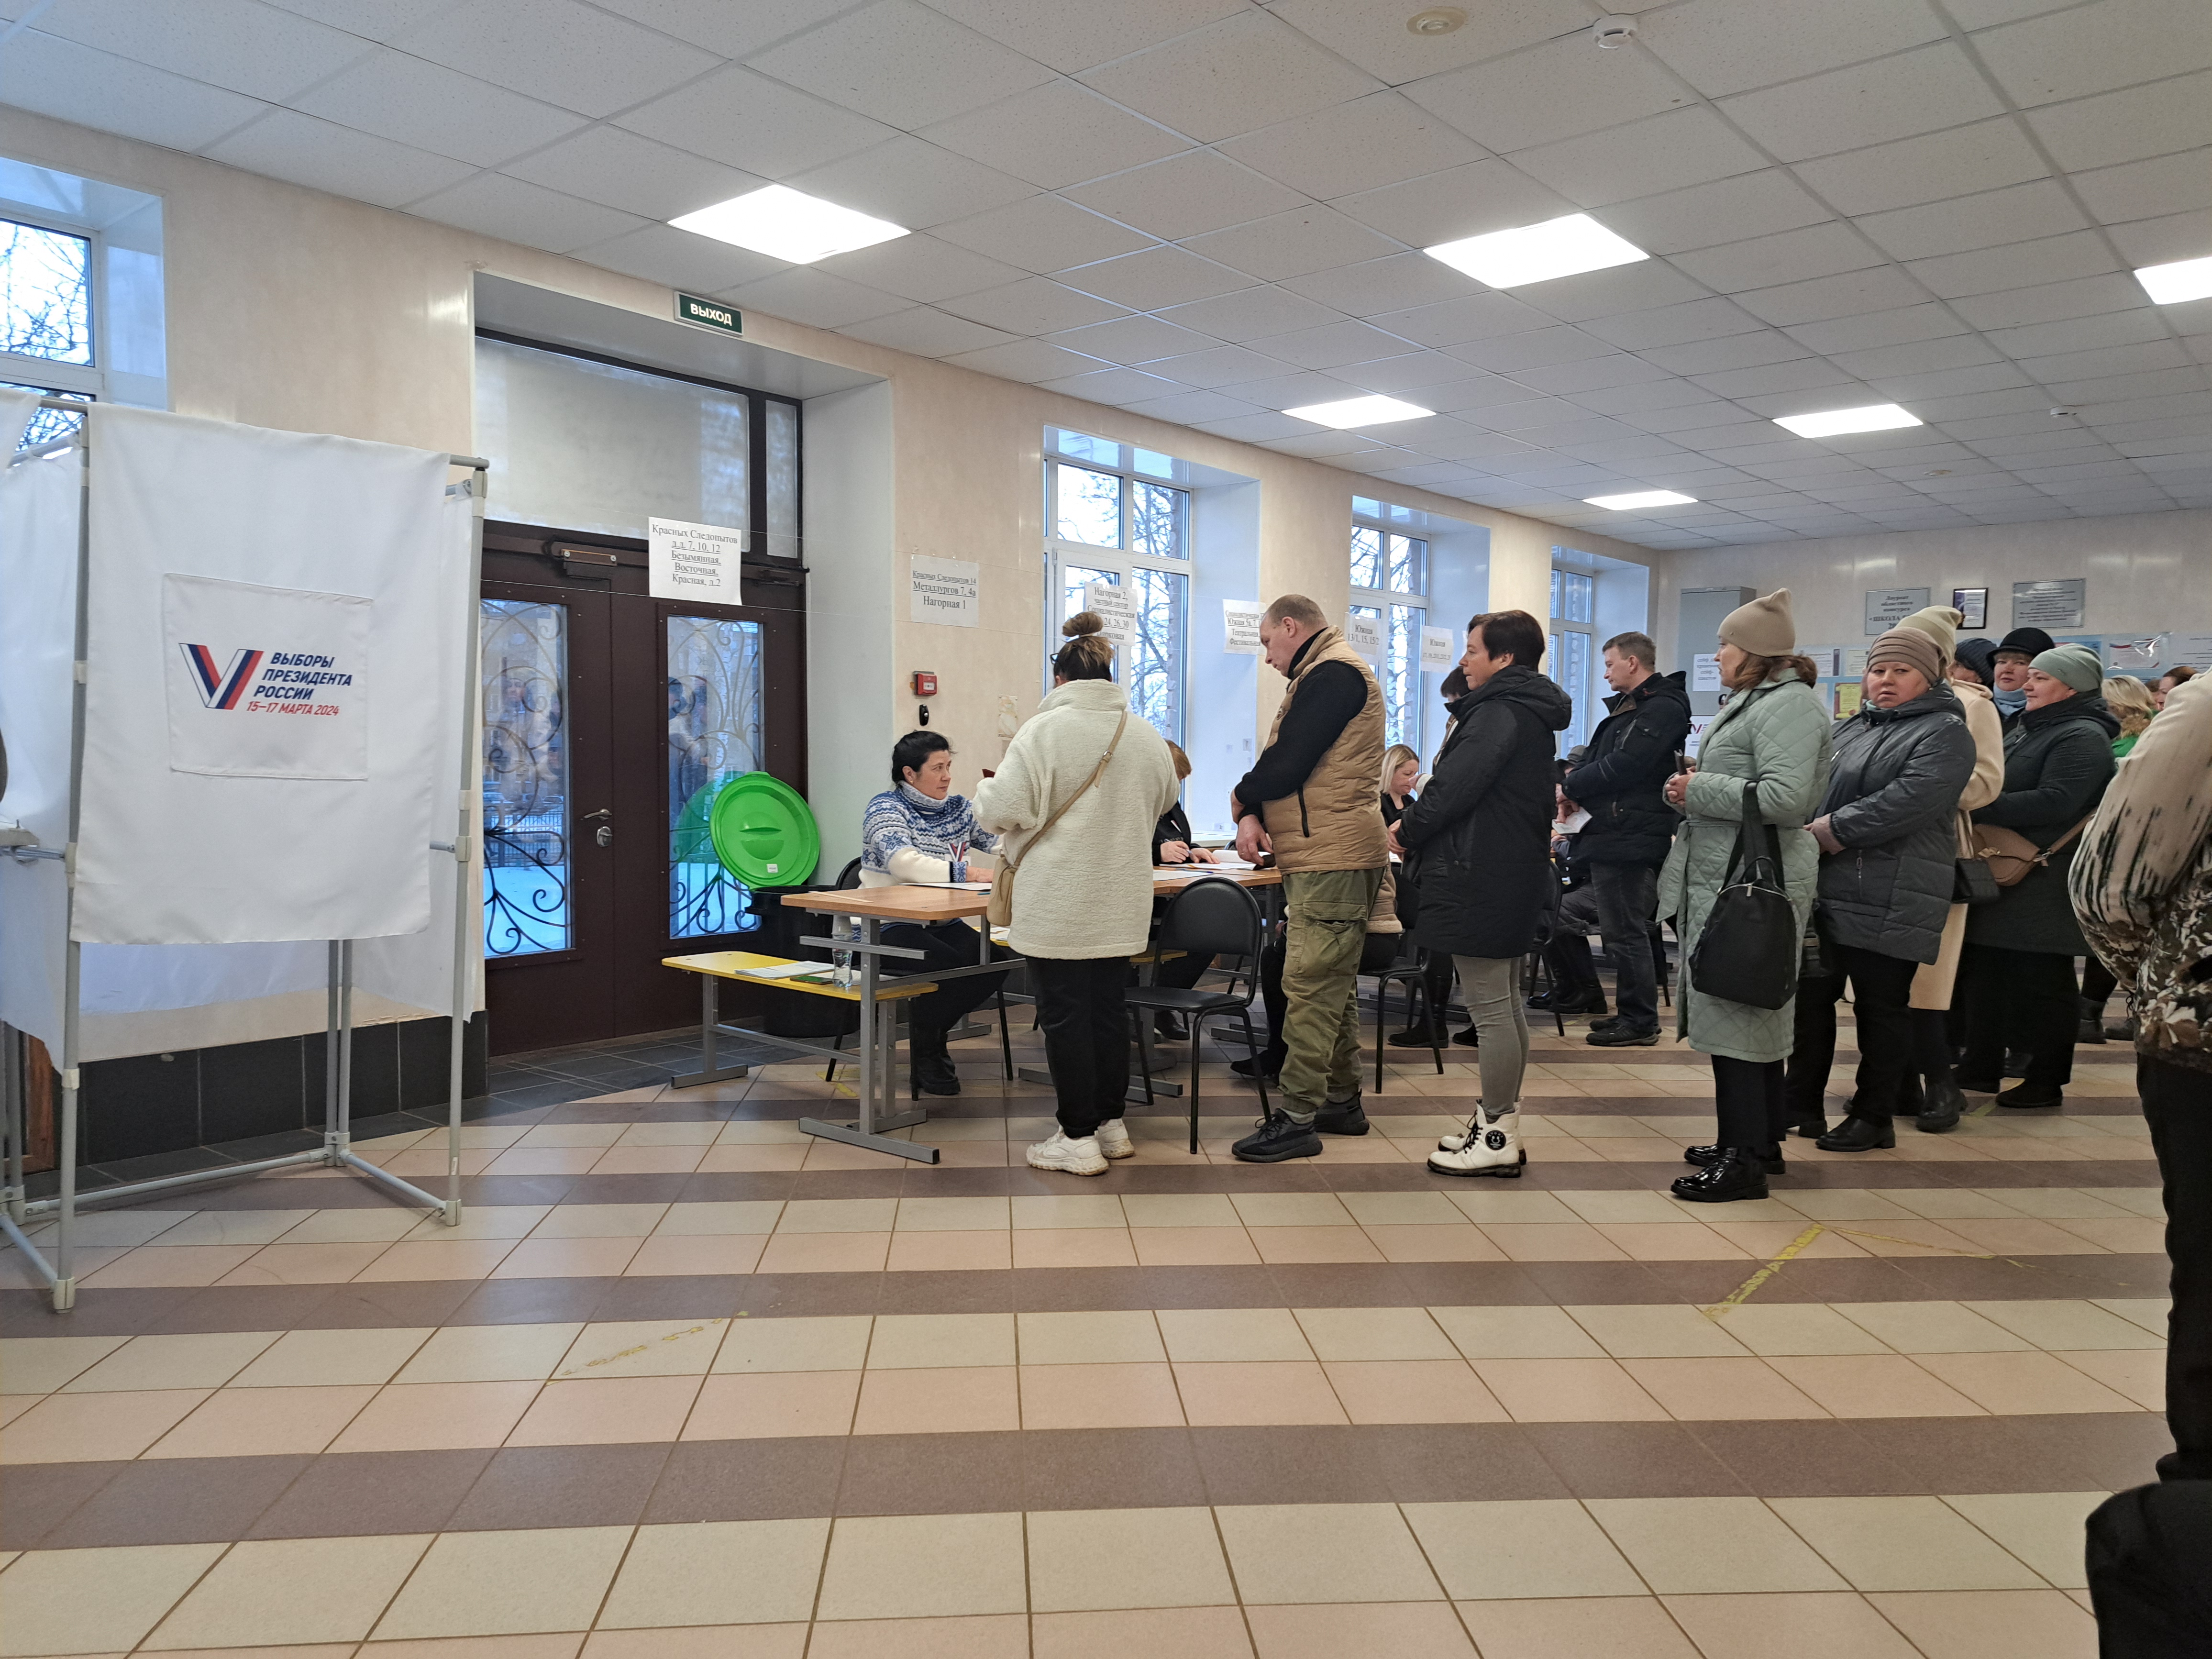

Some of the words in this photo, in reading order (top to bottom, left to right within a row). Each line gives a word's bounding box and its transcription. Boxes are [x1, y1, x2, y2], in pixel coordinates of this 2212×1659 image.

[690, 303, 732, 326] ВЫХОД
[652, 524, 688, 537] Красных
[690, 530, 738, 544] Следопытов
[712, 544, 721, 553] 12
[672, 574, 707, 586] Красная,
[913, 581, 959, 595] Металлургов
[968, 588, 976, 597] 4а
[923, 595, 960, 610] Нагорная
[270, 652, 335, 668] ВЫБОРЫ
[262, 668, 353, 686] ПРЕЗИДЕНТА
[253, 685, 314, 700] РОССИИ
[278, 702, 314, 715] МАРТА
[314, 704, 340, 716] 2024
